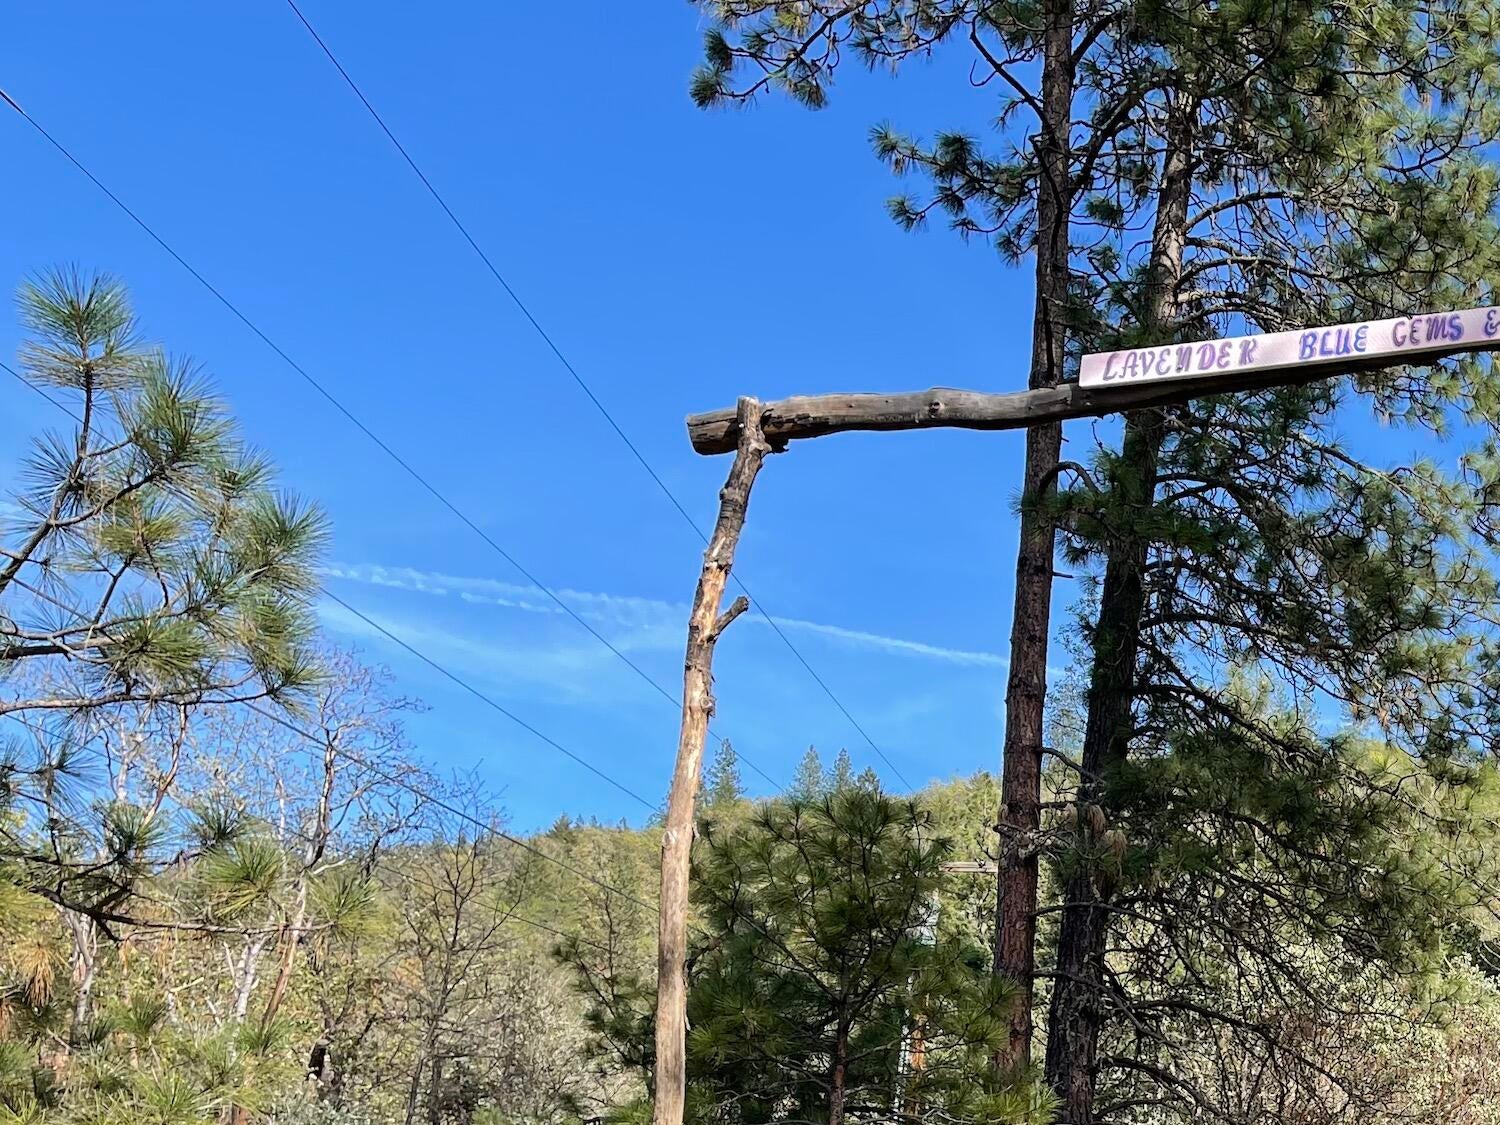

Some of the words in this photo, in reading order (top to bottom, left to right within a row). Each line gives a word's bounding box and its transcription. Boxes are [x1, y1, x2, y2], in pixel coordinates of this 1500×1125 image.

[1101, 337, 1259, 382] LAVENDER
[1299, 325, 1370, 360] BLUE
[1391, 312, 1465, 347] GEMS
